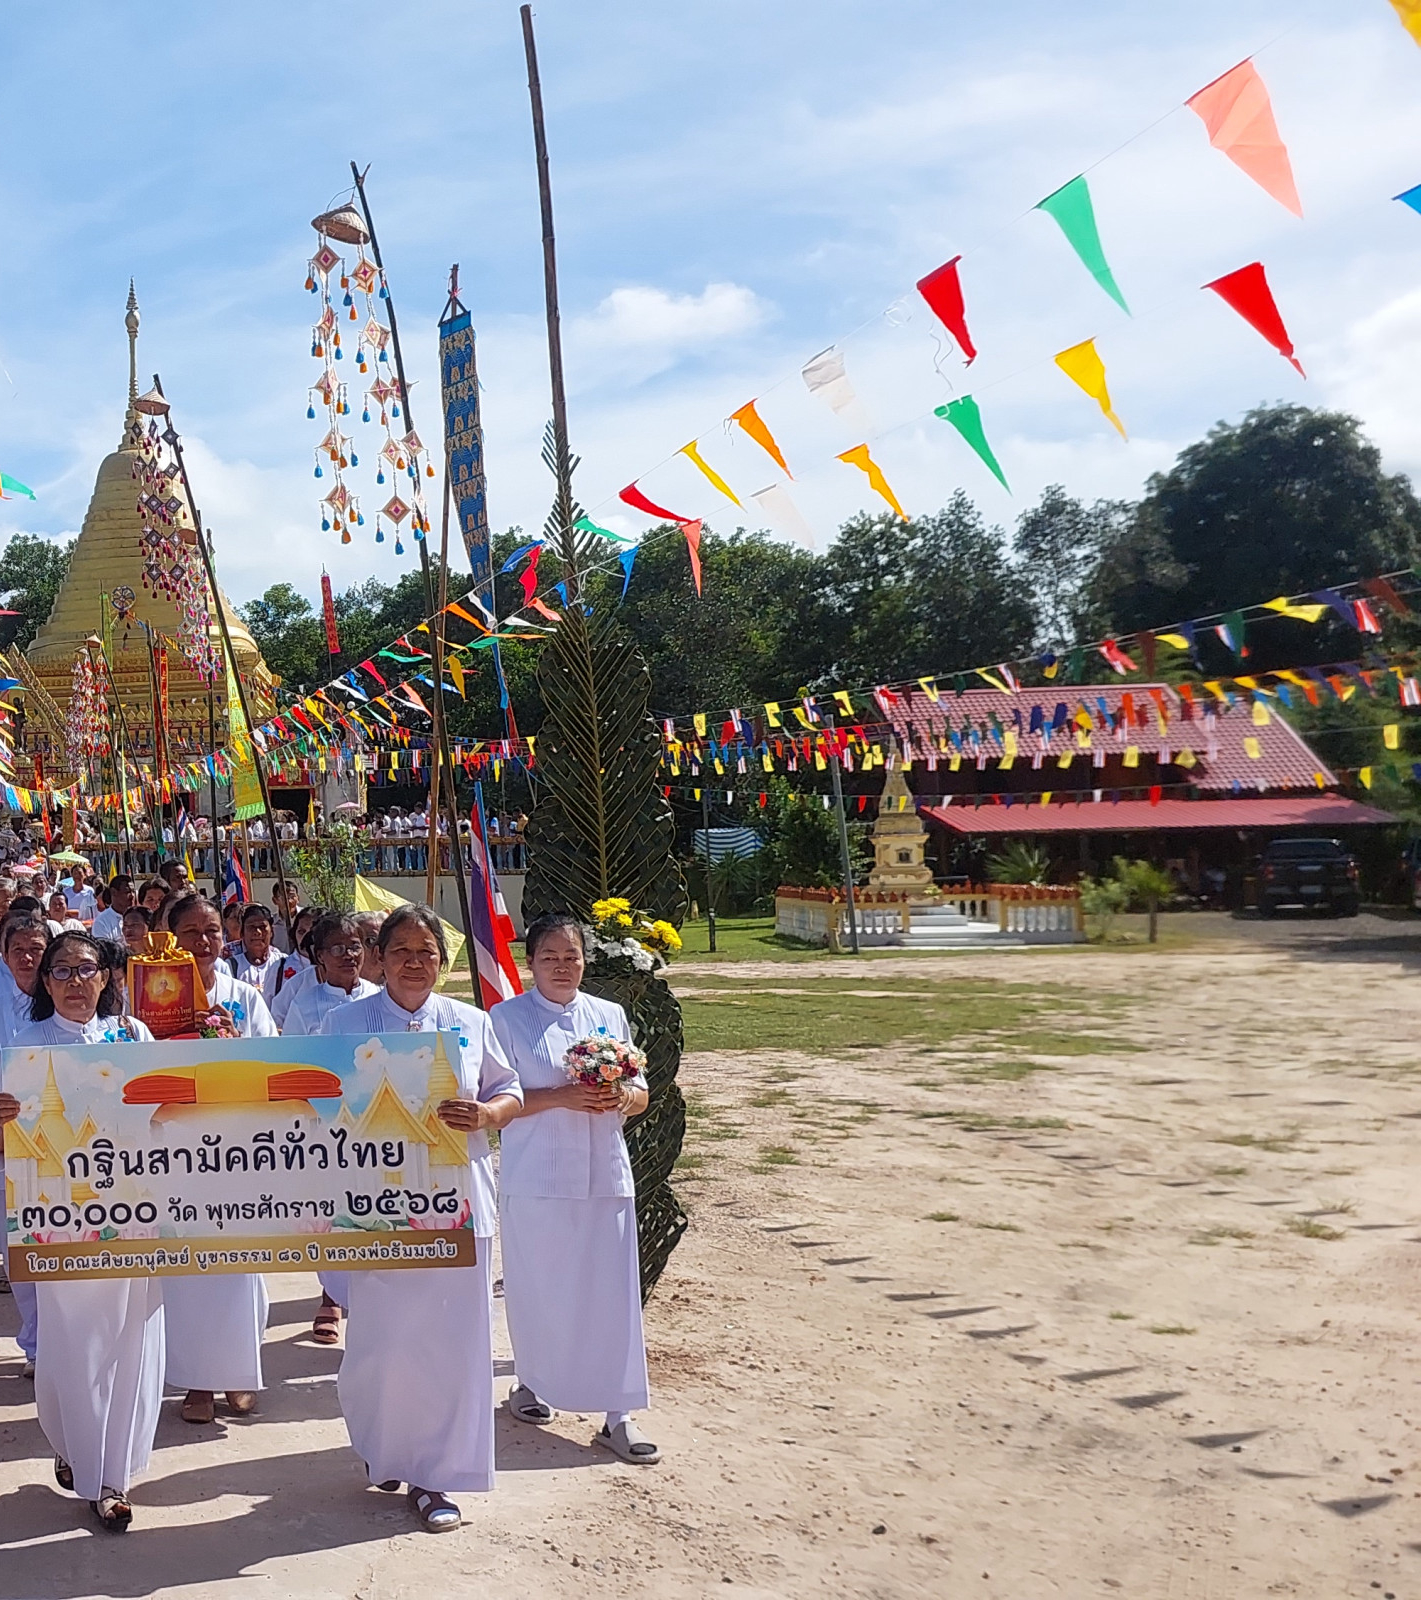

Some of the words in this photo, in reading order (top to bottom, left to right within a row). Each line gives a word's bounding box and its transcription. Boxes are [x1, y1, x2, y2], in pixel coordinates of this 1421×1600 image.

[67, 1120, 405, 1189] กฐินสามัคคีทั่วไทย
[22, 1201, 158, 1232] ๓๐,๐๐๐
[168, 1197, 197, 1222] วัด
[205, 1194, 335, 1230] พุทธศักราช
[345, 1187, 459, 1216] ๒๕๖๘
[27, 1254, 58, 1271] โดย
[65, 1246, 189, 1272] คณะศิษยานุศิษย์
[196, 1250, 271, 1270] บูชาธรรม
[278, 1250, 301, 1262] ๘๑
[307, 1243, 319, 1260] ปี
[326, 1240, 456, 1261] หลวงพ่อธัมมชโย
